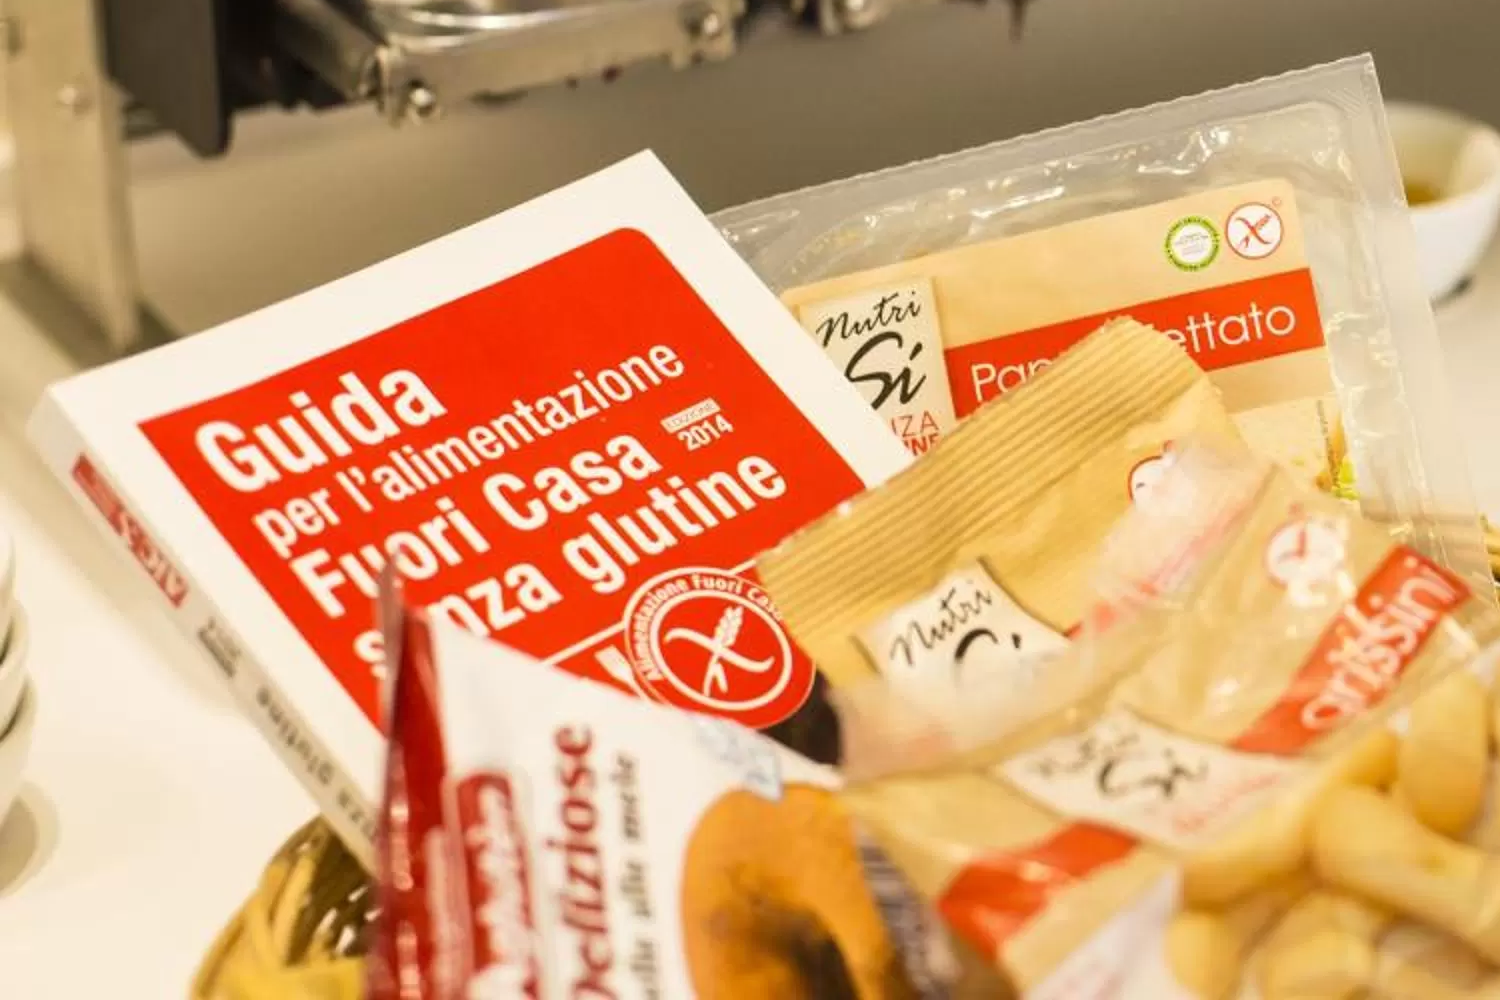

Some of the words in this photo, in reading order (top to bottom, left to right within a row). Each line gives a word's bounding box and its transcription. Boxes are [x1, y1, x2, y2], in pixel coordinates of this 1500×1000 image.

[195, 369, 449, 493] Guida
[251, 488, 341, 559] per
[334, 344, 685, 513] l'alimentazione
[677, 412, 734, 452] 2014
[971, 358, 1053, 402] Pan
[289, 496, 492, 619] Fuori
[482, 434, 663, 531] Casa
[353, 563, 564, 682] snza
[562, 455, 788, 594] glutine
